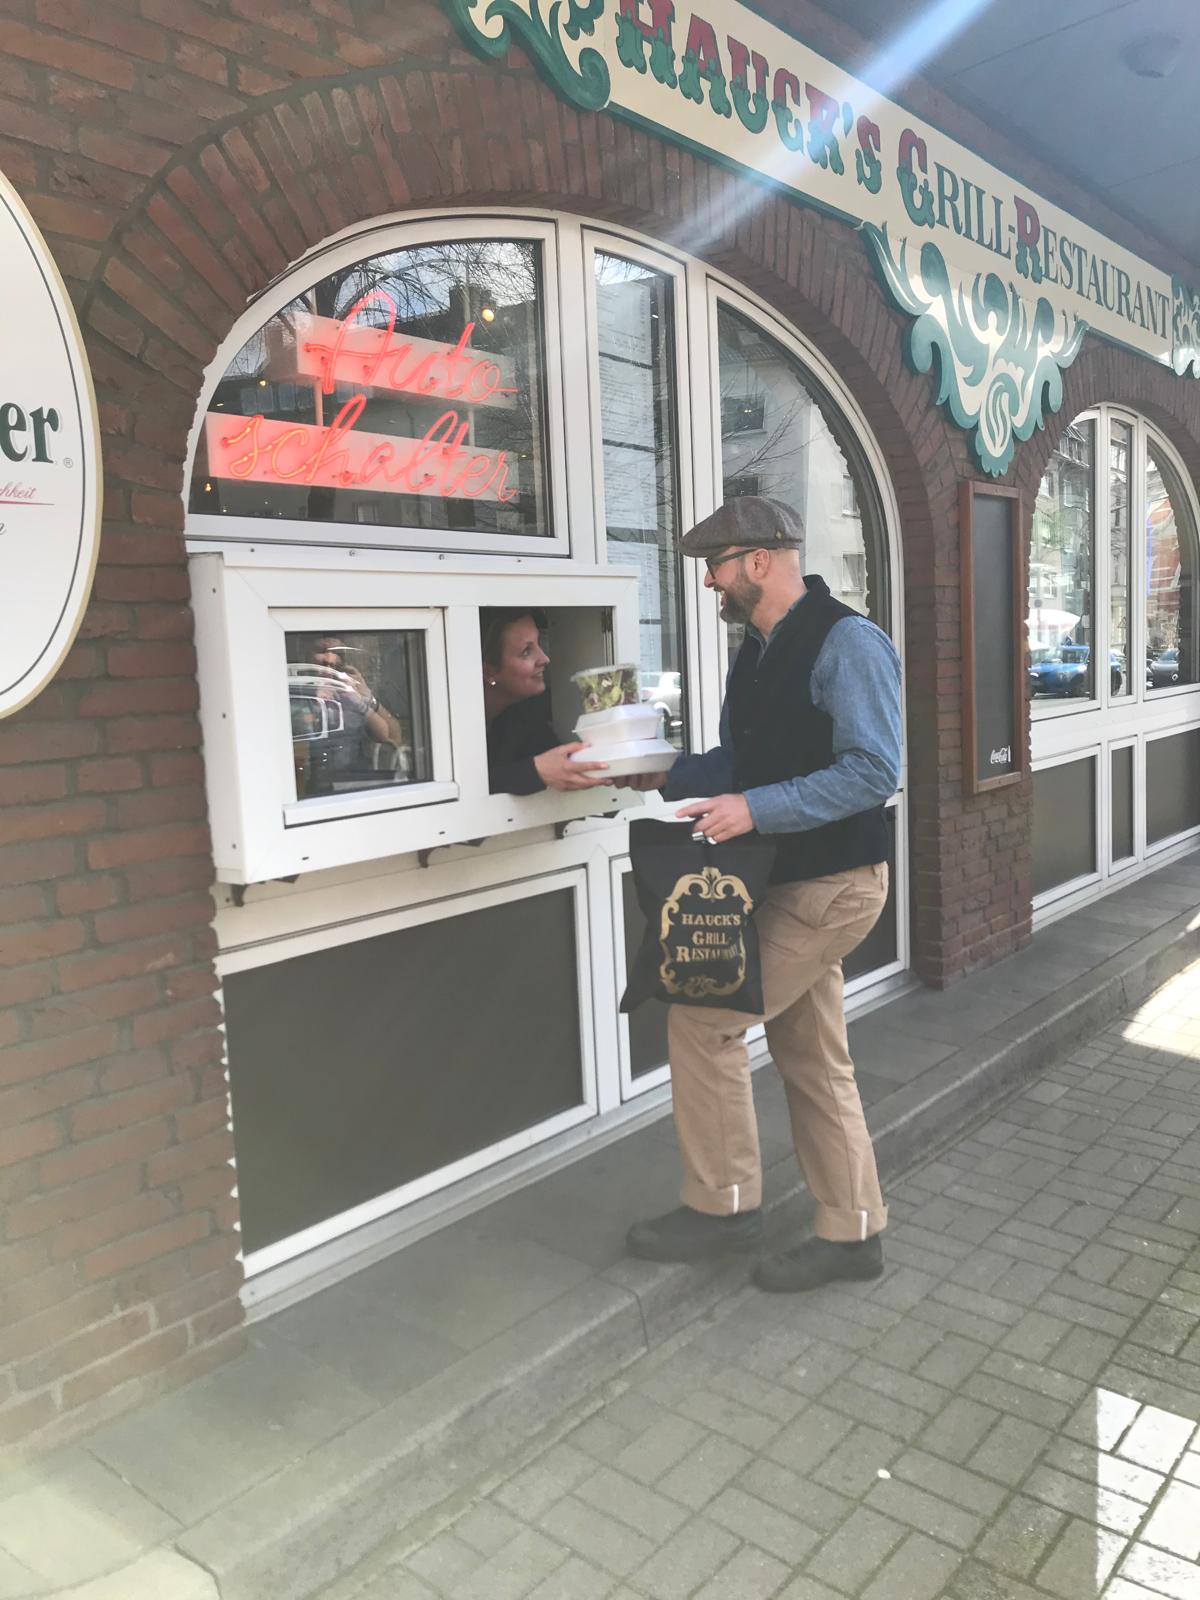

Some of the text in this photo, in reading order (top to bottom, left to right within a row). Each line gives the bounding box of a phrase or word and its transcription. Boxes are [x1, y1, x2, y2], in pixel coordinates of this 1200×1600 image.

[615, 0, 882, 194] HAUCK'S
[303, 291, 519, 402] Auto
[682, 913, 741, 926] HAUCK'S
